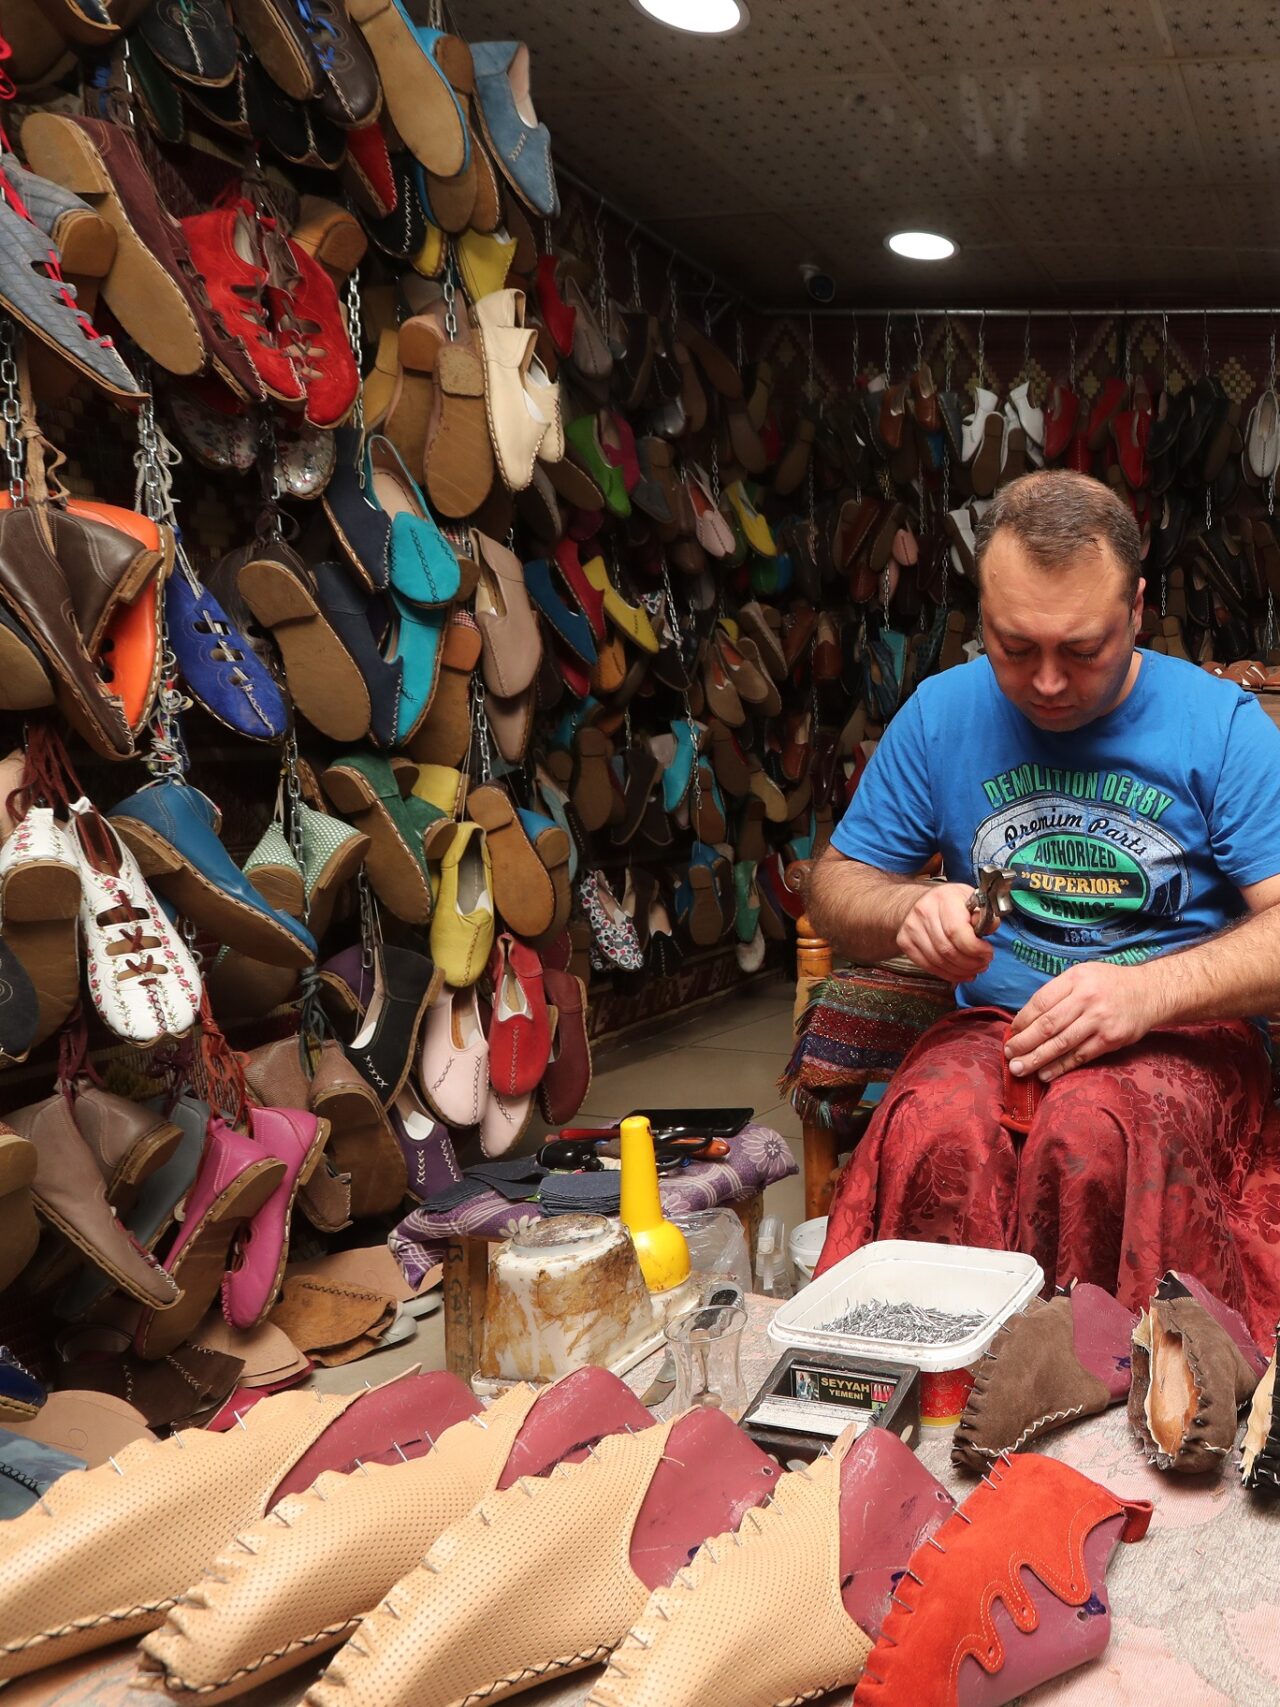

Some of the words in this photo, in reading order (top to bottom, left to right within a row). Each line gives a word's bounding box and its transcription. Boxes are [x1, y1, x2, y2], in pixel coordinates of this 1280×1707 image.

[983, 763, 1099, 808] DEMOLITION
[1102, 772, 1174, 821] DERBY
[1004, 809, 1082, 850] Premium
[1087, 818, 1148, 857] Parts
[1034, 840, 1117, 869] AUTHORIZED
[820, 1377, 870, 1393] SEYYAH
